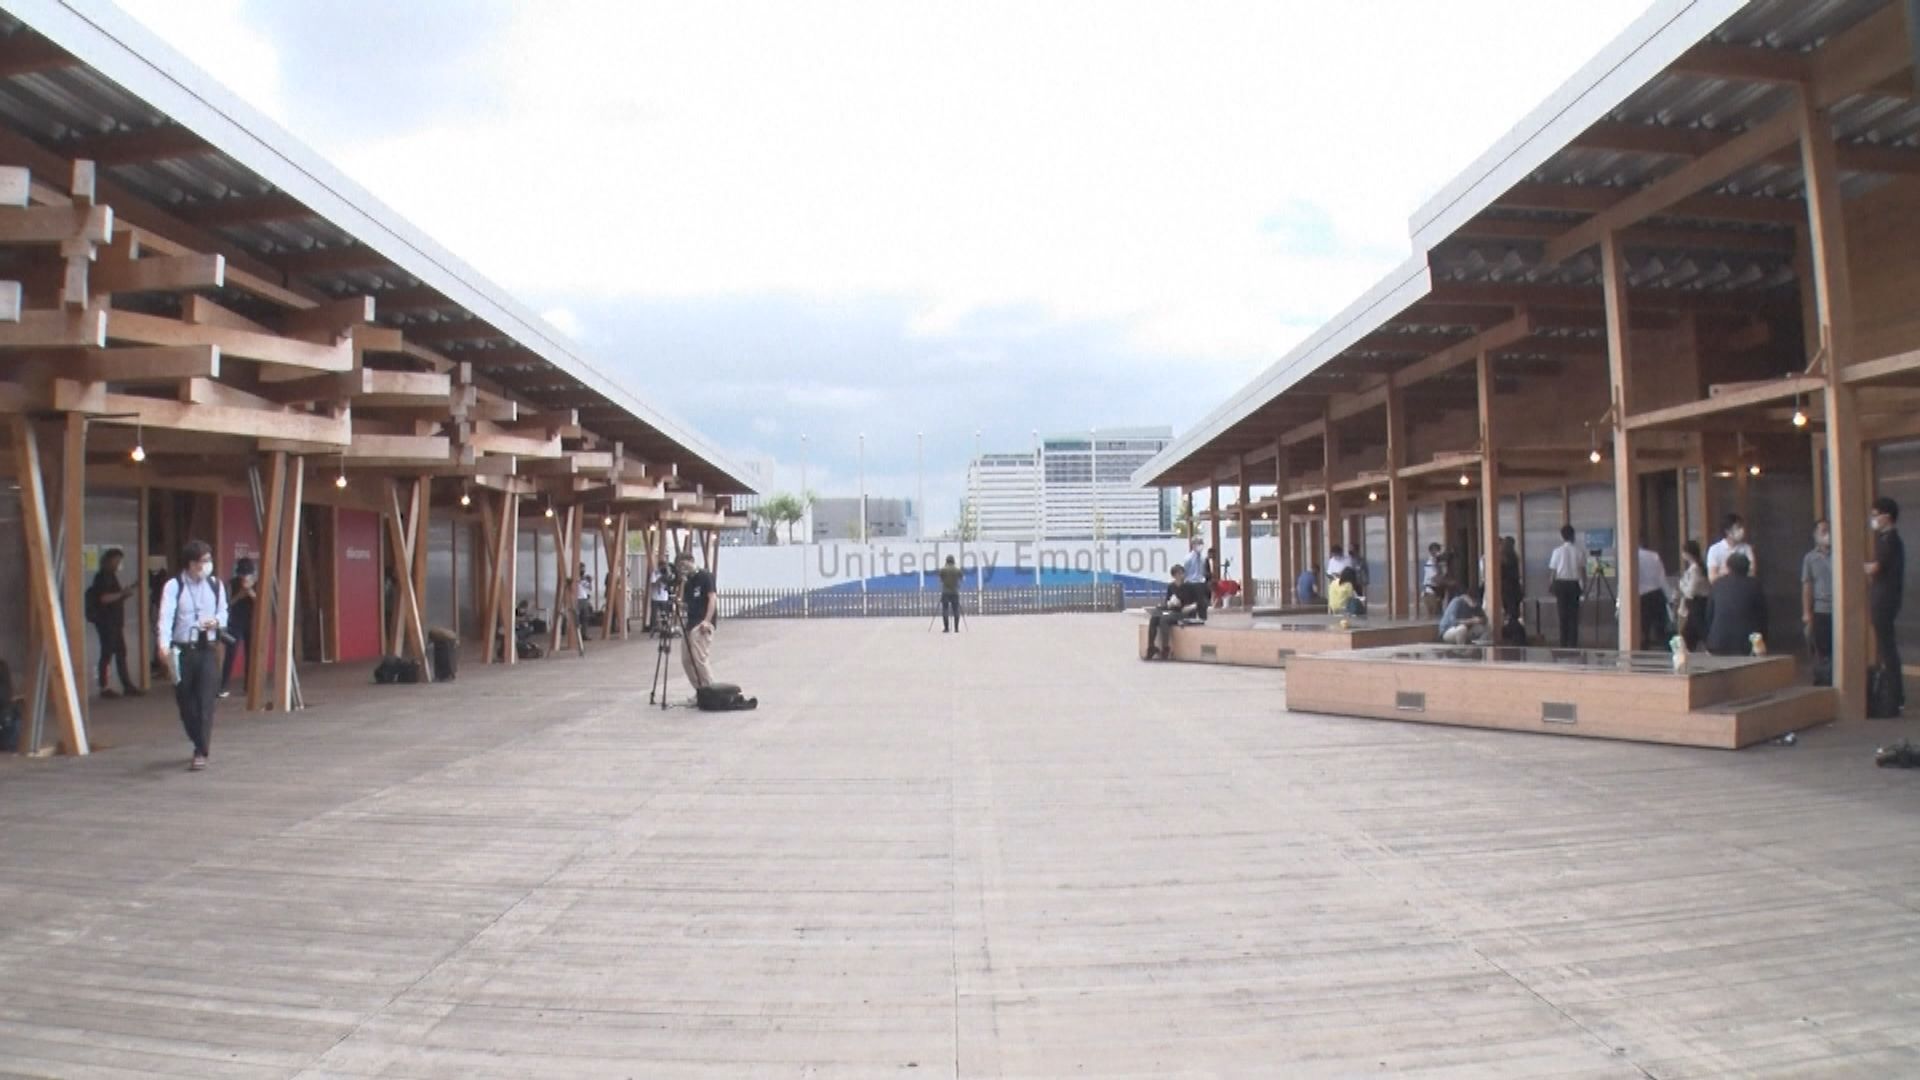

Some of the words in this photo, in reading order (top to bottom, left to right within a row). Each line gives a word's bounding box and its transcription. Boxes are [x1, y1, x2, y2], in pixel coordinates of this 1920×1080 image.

[819, 542, 940, 578] United
[960, 541, 999, 583] by
[1015, 537, 1168, 574] Emotion
